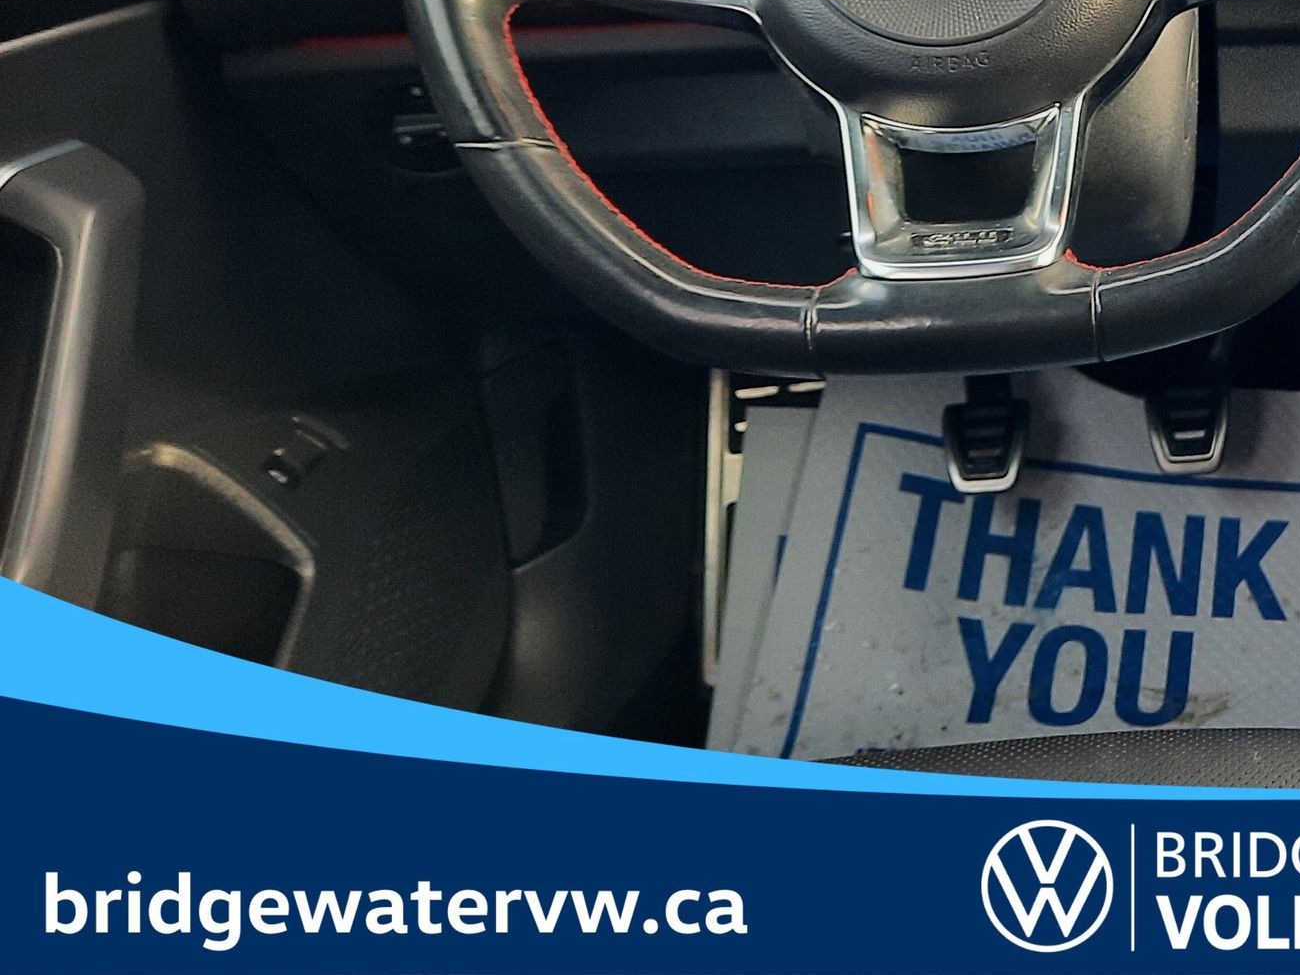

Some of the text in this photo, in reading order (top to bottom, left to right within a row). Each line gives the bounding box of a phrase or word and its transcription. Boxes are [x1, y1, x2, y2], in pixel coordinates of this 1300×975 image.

[910, 50, 990, 73] AIRBAG
[899, 472, 1289, 622] THANK
[957, 616, 1195, 727] YOU
